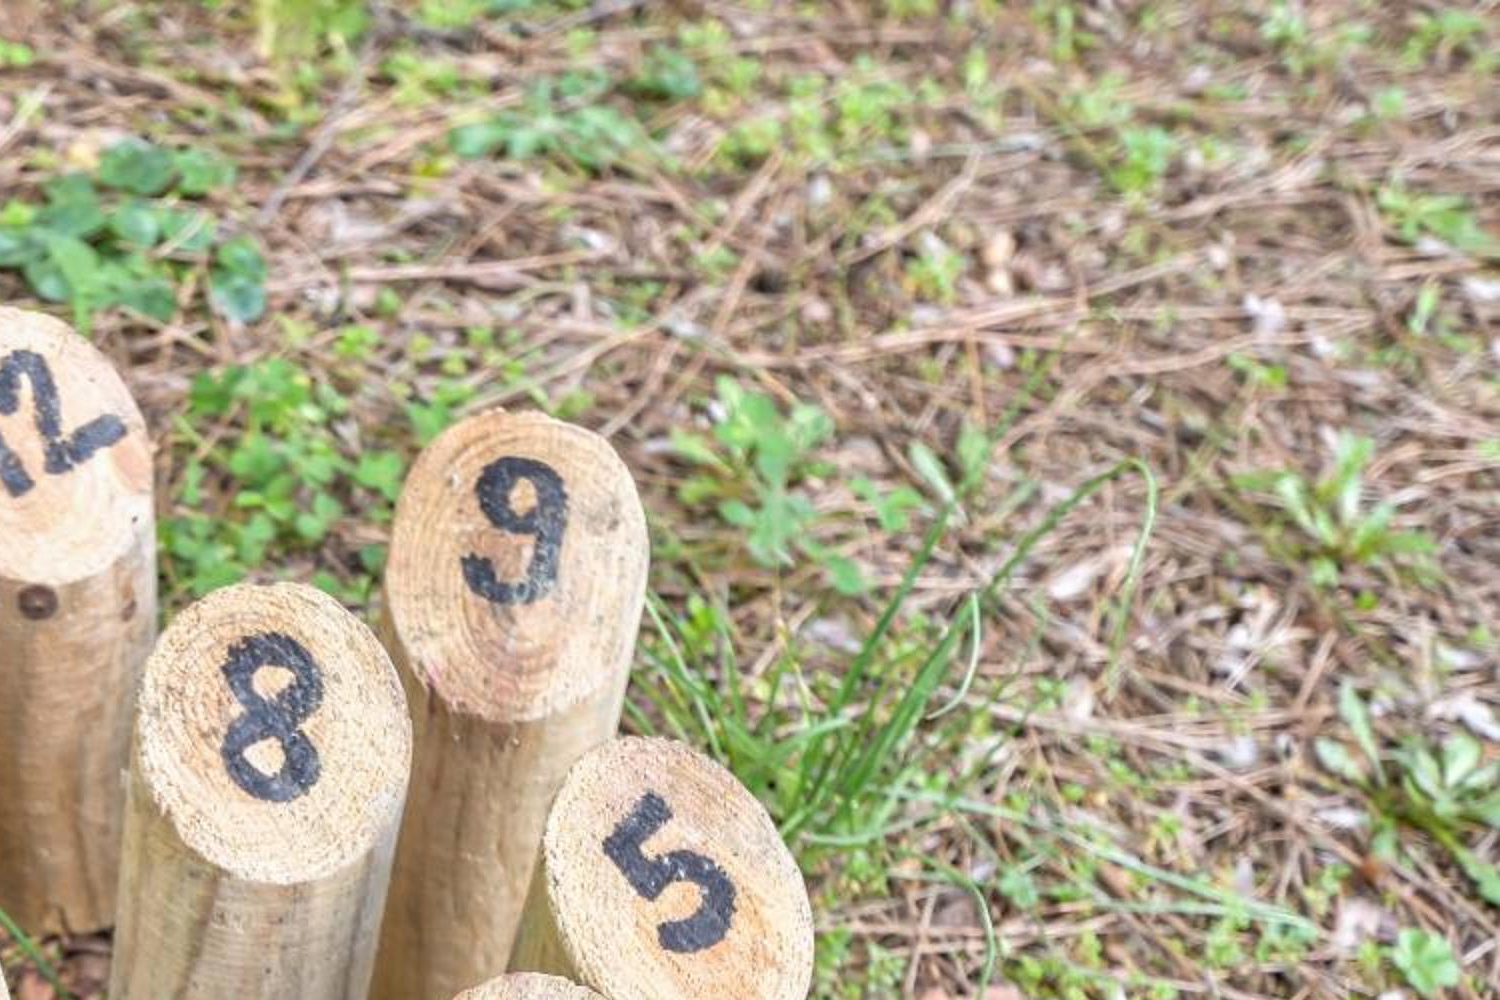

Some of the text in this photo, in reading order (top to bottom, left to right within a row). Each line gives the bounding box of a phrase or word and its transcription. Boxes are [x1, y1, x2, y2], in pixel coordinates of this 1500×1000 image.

[463, 457, 568, 606] 9
[222, 633, 323, 800] 8
[603, 793, 735, 952] 5
